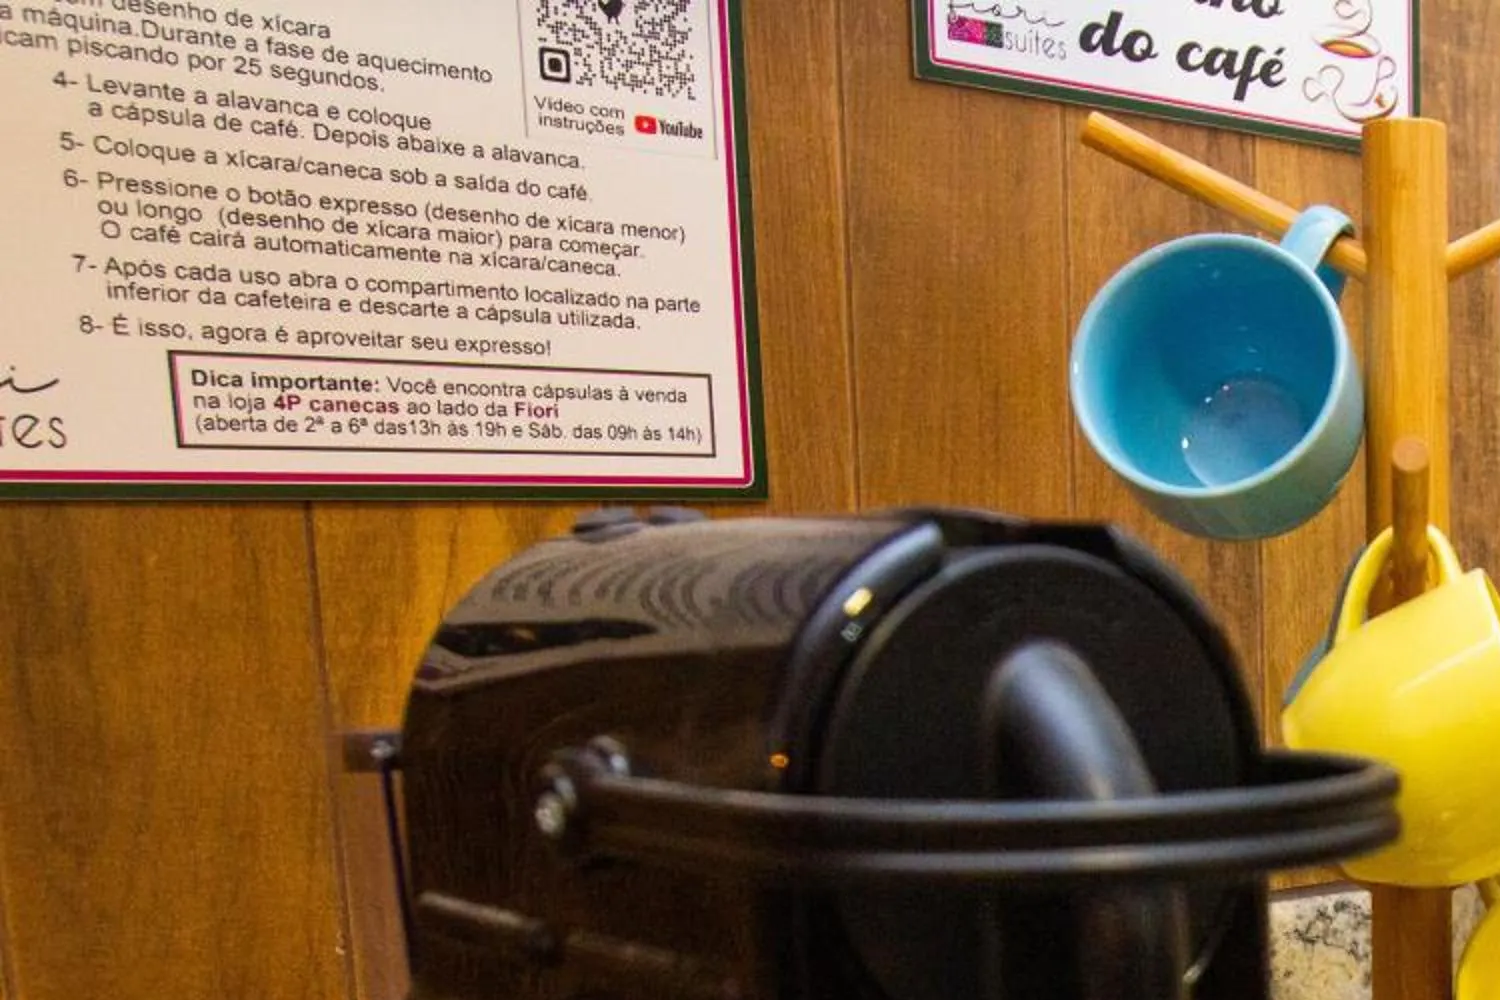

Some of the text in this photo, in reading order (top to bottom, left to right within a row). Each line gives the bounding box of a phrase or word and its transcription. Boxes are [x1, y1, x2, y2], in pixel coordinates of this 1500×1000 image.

[111, 0, 217, 23] desenho
[224, 11, 253, 29] de
[67, 34, 179, 66] piscando
[187, 53, 225, 72] por
[233, 56, 262, 75] 25
[271, 63, 385, 92] segundos.
[245, 37, 258, 52] a
[266, 36, 314, 60] fase
[322, 46, 349, 64] de
[357, 53, 493, 83] aquecimento
[1006, 30, 1066, 60] suites
[1079, 10, 1286, 101] do café
[52, 70, 432, 131] 4- Levante a alavanca e coloque
[590, 104, 625, 119] com
[88, 101, 585, 169] a cápsula de café. Depois abaixe a alavanca.
[538, 113, 625, 136] instruções
[658, 120, 703, 139] YouTube
[59, 132, 84, 151] 5-
[93, 135, 196, 165] Coloque
[204, 150, 217, 164] a
[390, 168, 428, 185] sob
[435, 173, 447, 187] a
[454, 173, 509, 193] saída
[516, 179, 541, 197] do
[63, 169, 88, 188] 6-
[97, 171, 218, 200] Pressione
[226, 187, 241, 202] o
[249, 186, 311, 209] botão
[319, 193, 417, 217] expresso
[425, 201, 520, 227] (desenho
[525, 212, 550, 230] de
[621, 222, 685, 244] menor)
[98, 200, 128, 217] ou
[137, 200, 203, 225] longo
[219, 207, 325, 232] (desenho
[332, 217, 358, 235] de
[438, 227, 503, 249] maior)
[510, 234, 552, 251] para
[101, 220, 120, 238] O
[131, 223, 181, 244] café
[190, 229, 246, 249] cairá
[253, 234, 441, 263] automaticamente
[449, 249, 473, 265] na
[71, 254, 701, 314] 7- Após cada uso abra o compartimento localizado na parte
[107, 284, 641, 330] inferior da cafeteira e descarte a cápsula utilizada.
[79, 315, 104, 334] 8-
[113, 314, 130, 337] É
[201, 324, 267, 344] agora
[275, 326, 288, 344] é
[296, 329, 403, 349] aproveitar
[411, 334, 448, 351] seu
[455, 336, 551, 357] expresso!
[191, 369, 243, 388] Dica
[251, 374, 379, 393] importante:
[386, 376, 437, 394] Você
[444, 381, 527, 398] encontra
[533, 383, 613, 402] cápsulas
[635, 387, 687, 403] venda
[194, 394, 560, 419] na loja 4P canecas ao lado da Fiori
[195, 414, 267, 435] (aberta
[274, 416, 298, 433] de
[331, 420, 342, 433] a
[476, 422, 507, 437] 19h
[513, 425, 522, 438] e
[573, 424, 602, 440] das
[607, 426, 638, 440] 09h
[668, 427, 702, 443] 14h)
